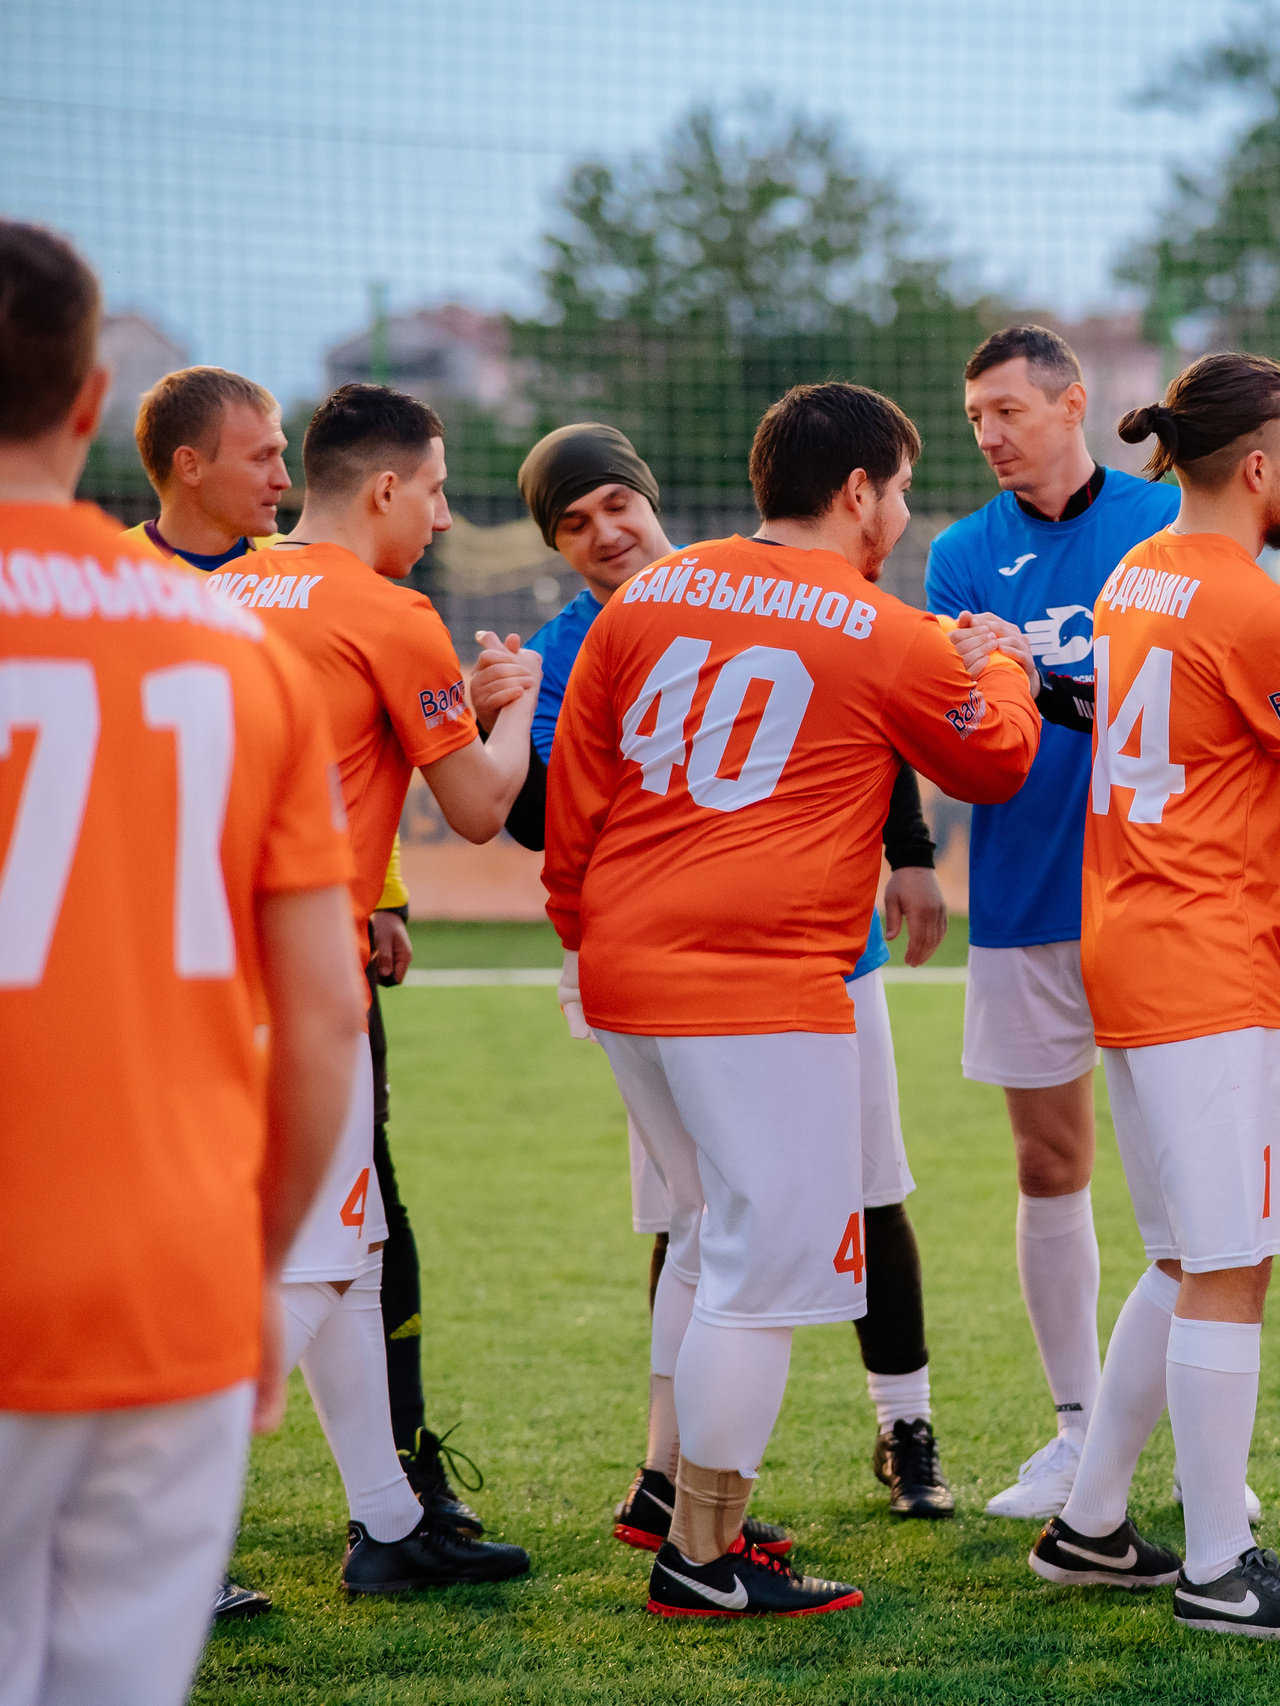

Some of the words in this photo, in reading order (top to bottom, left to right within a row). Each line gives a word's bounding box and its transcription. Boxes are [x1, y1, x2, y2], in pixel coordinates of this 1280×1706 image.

[622, 557, 878, 640] БАЙЗЫХАНОВ
[1100, 562, 1201, 620] ВДЮНИН
[619, 635, 815, 813] 40
[1091, 634, 1186, 824] 14
[0, 656, 236, 992] 71
[832, 1211, 867, 1285] 4
